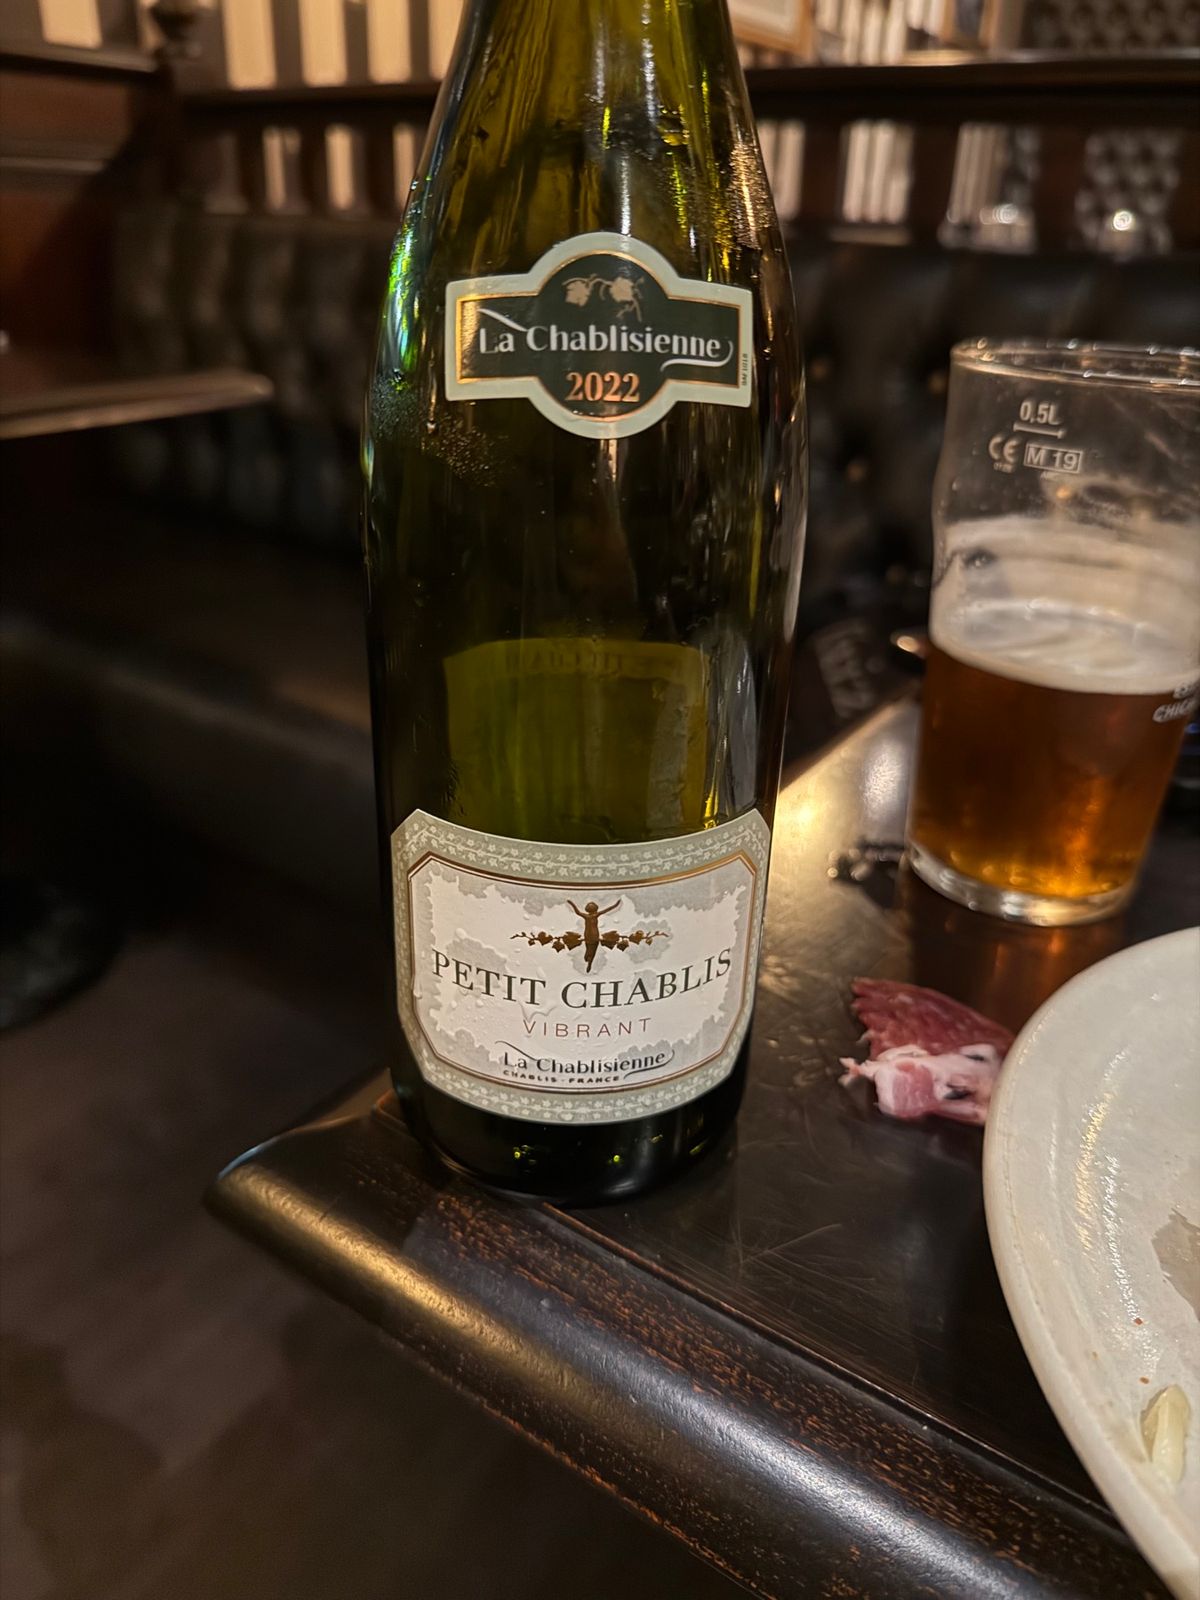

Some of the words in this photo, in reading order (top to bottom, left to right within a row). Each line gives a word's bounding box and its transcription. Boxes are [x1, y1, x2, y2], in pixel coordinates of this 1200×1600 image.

[479, 327, 514, 355] La
[526, 323, 733, 371] Chablisienne
[565, 372, 641, 403] 2022
[1027, 447, 1047, 466] M
[1053, 451, 1078, 471] 19
[432, 948, 546, 1007] PETIT
[561, 948, 731, 1009] CHABLIS
[522, 1018, 651, 1038] VIBRANT
[503, 1052, 528, 1069] La
[536, 1049, 675, 1079] Chablisienne
[503, 1070, 557, 1082] CHABLIS
[568, 1075, 620, 1084] FRANCE
